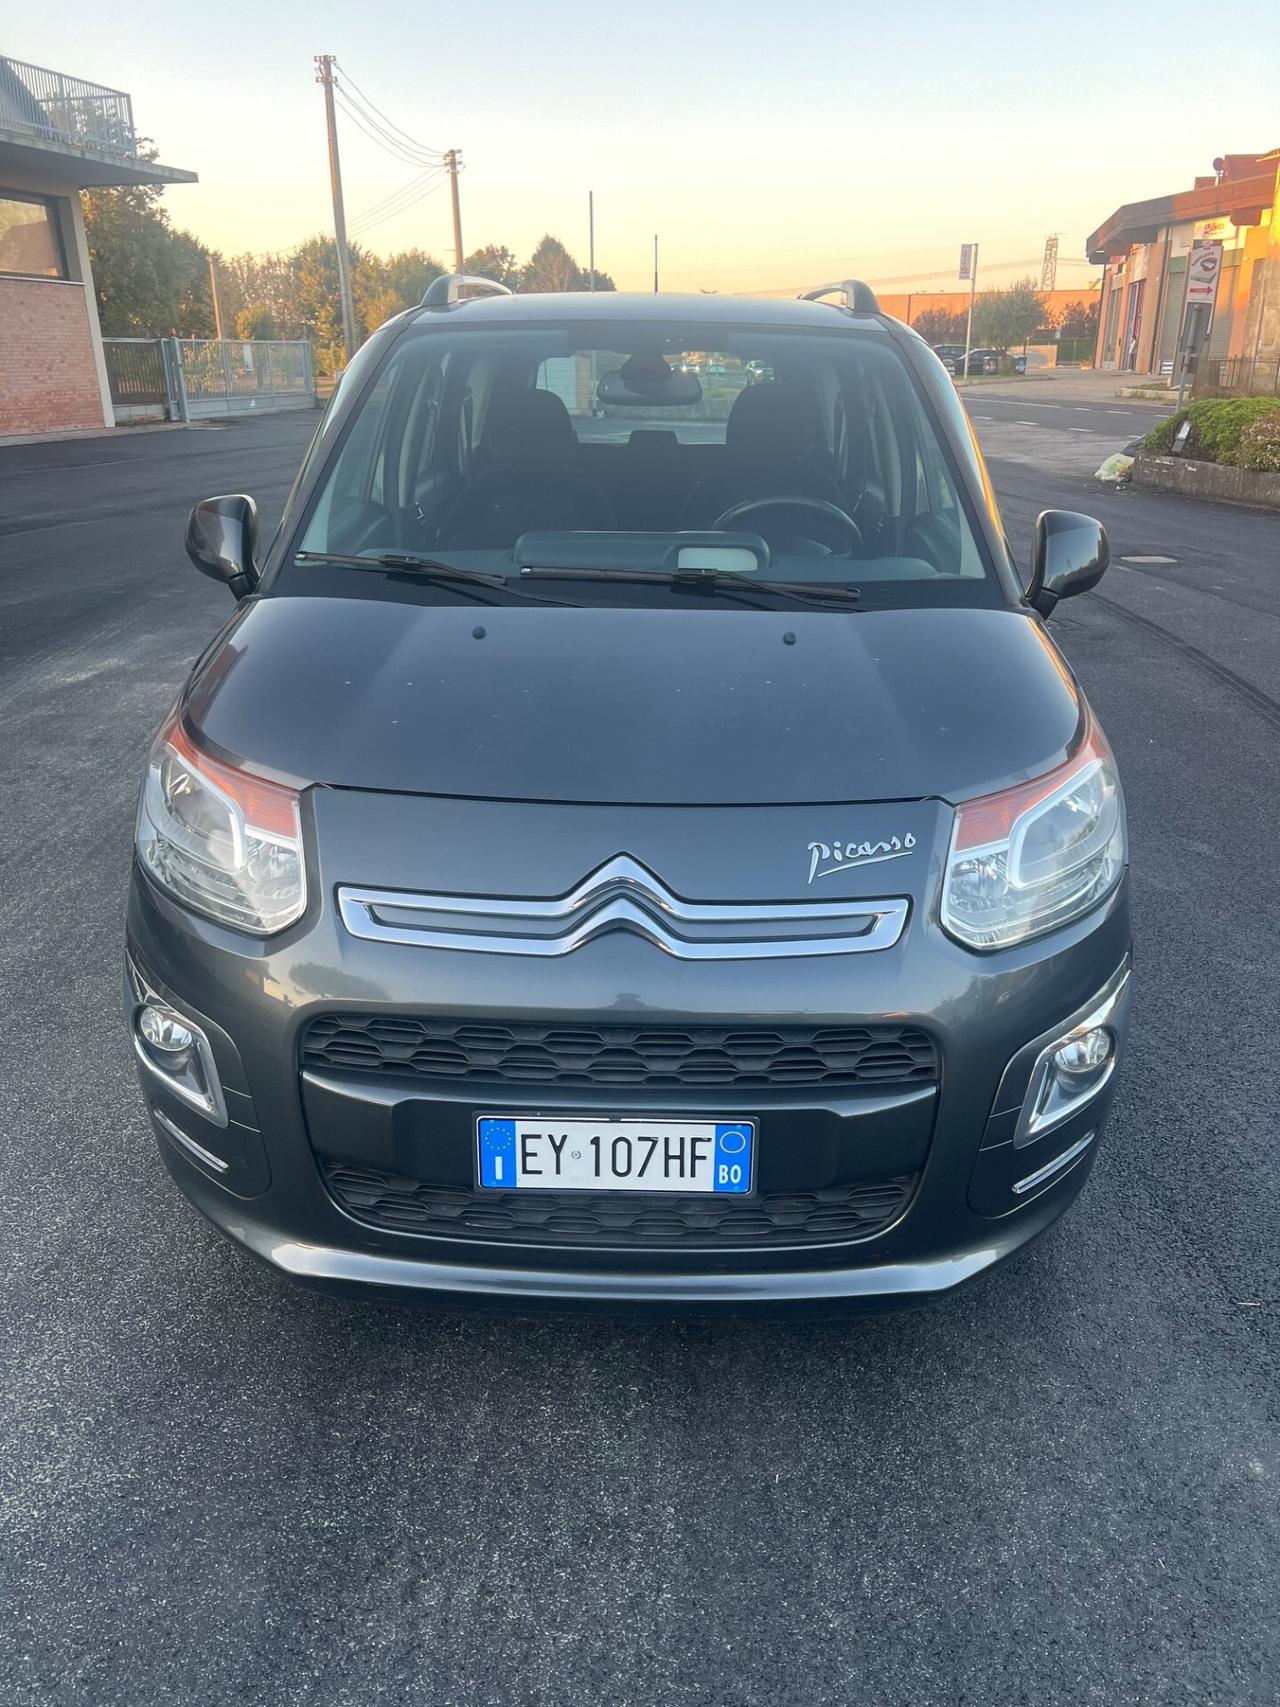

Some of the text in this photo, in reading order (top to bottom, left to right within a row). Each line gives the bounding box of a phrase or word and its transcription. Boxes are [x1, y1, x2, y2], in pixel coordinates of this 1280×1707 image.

[807, 832, 917, 885] Picasso
[520, 1134, 712, 1178] EY 107HF
[718, 1164, 742, 1185] BO
